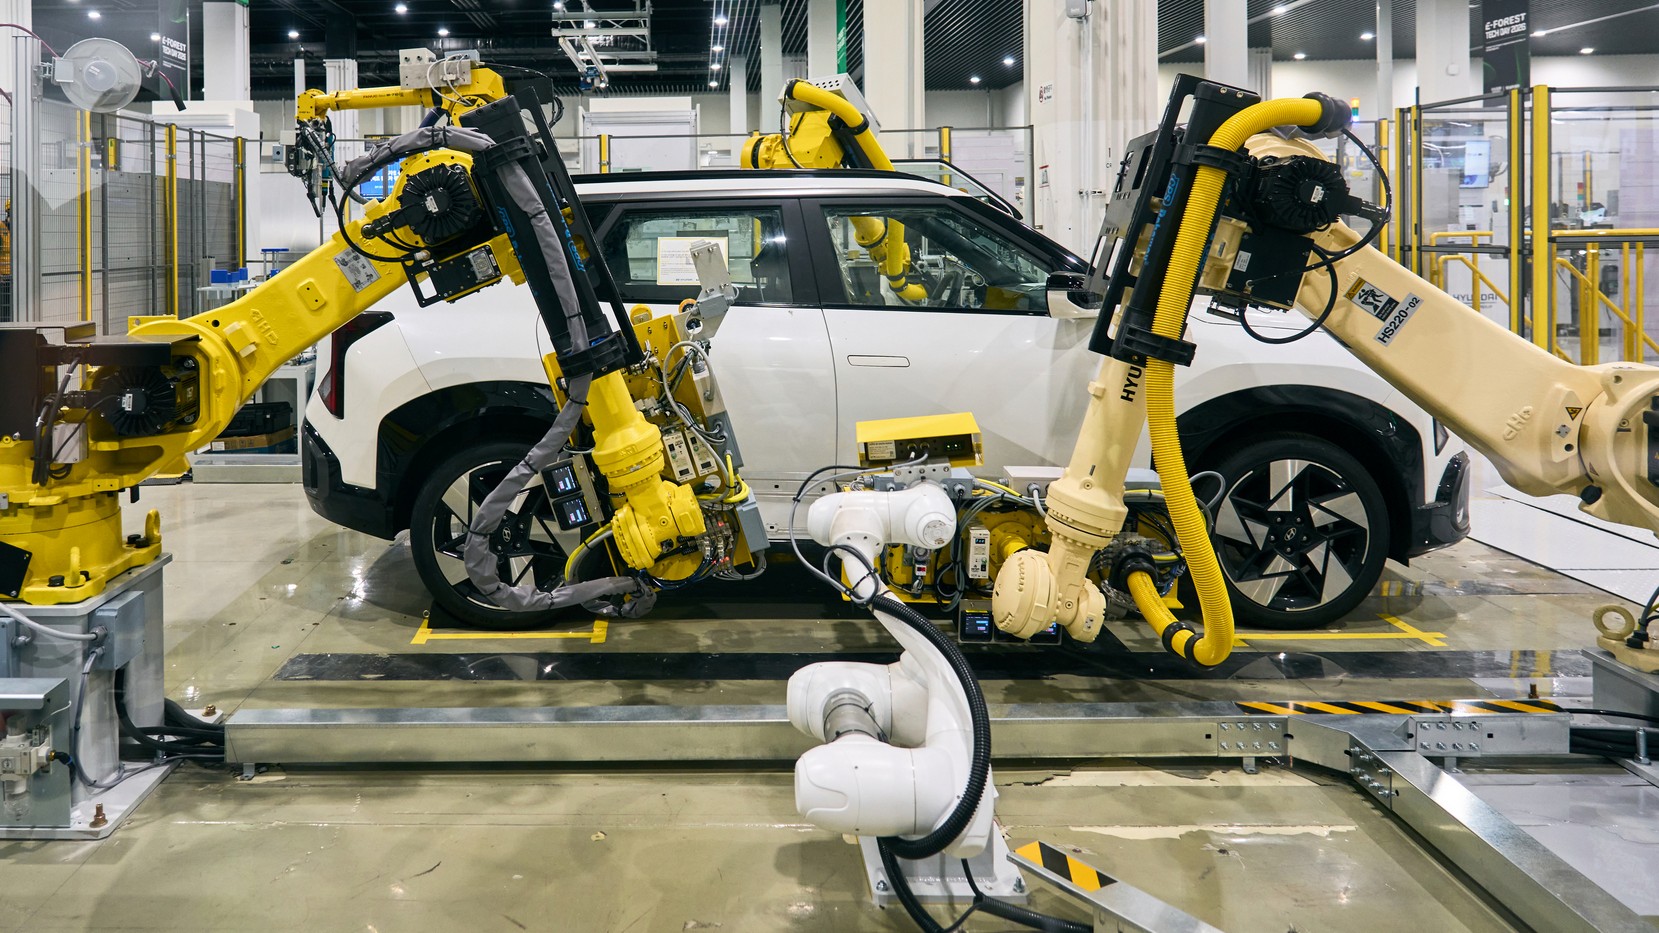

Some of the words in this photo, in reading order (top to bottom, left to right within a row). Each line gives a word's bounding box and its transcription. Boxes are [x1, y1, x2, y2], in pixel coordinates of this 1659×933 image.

[1485, 13, 1526, 30] E-FOREST
[1485, 31, 1499, 39] TECH
[1500, 27, 1511, 36] DAY
[1378, 297, 1420, 343] HS220-02
[1121, 366, 1142, 402] HYU
